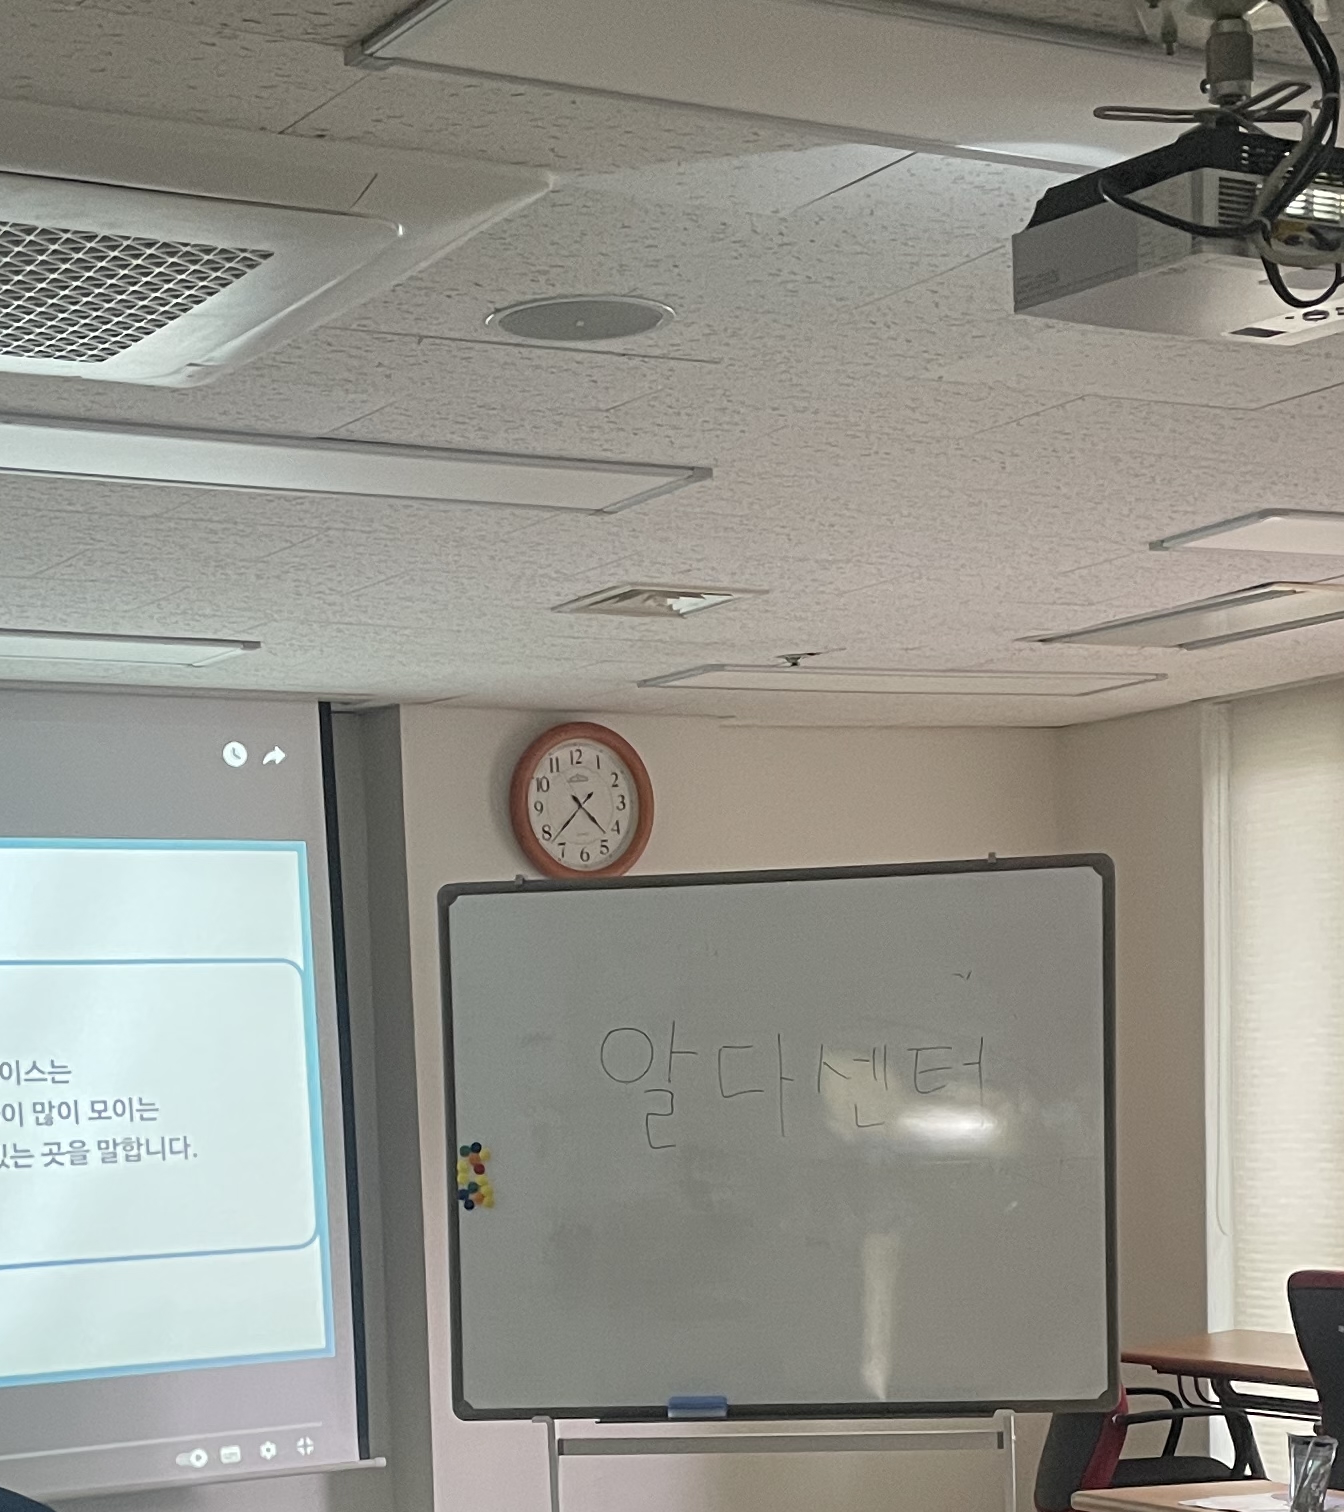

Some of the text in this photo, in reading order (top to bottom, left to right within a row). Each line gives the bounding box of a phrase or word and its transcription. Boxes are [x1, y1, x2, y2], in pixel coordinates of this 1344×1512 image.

[549, 756, 559, 773] 11
[570, 749, 582, 765] 12
[596, 755, 600, 769] 1
[536, 776, 549, 792] 10
[611, 772, 619, 788] 2
[534, 801, 544, 816] 9
[616, 795, 626, 811] 3
[542, 825, 552, 840] 8
[611, 820, 620, 835] 4
[558, 842, 566, 858] 7
[580, 848, 590, 862] 6
[600, 840, 609, 855] 5
[599, 1020, 985, 1149] 알다센터
[32, 1099, 80, 1126] 많이
[87, 1096, 160, 1123] 모이는
[40, 1139, 91, 1167] 곳을
[96, 1134, 198, 1164] 말합니다.
